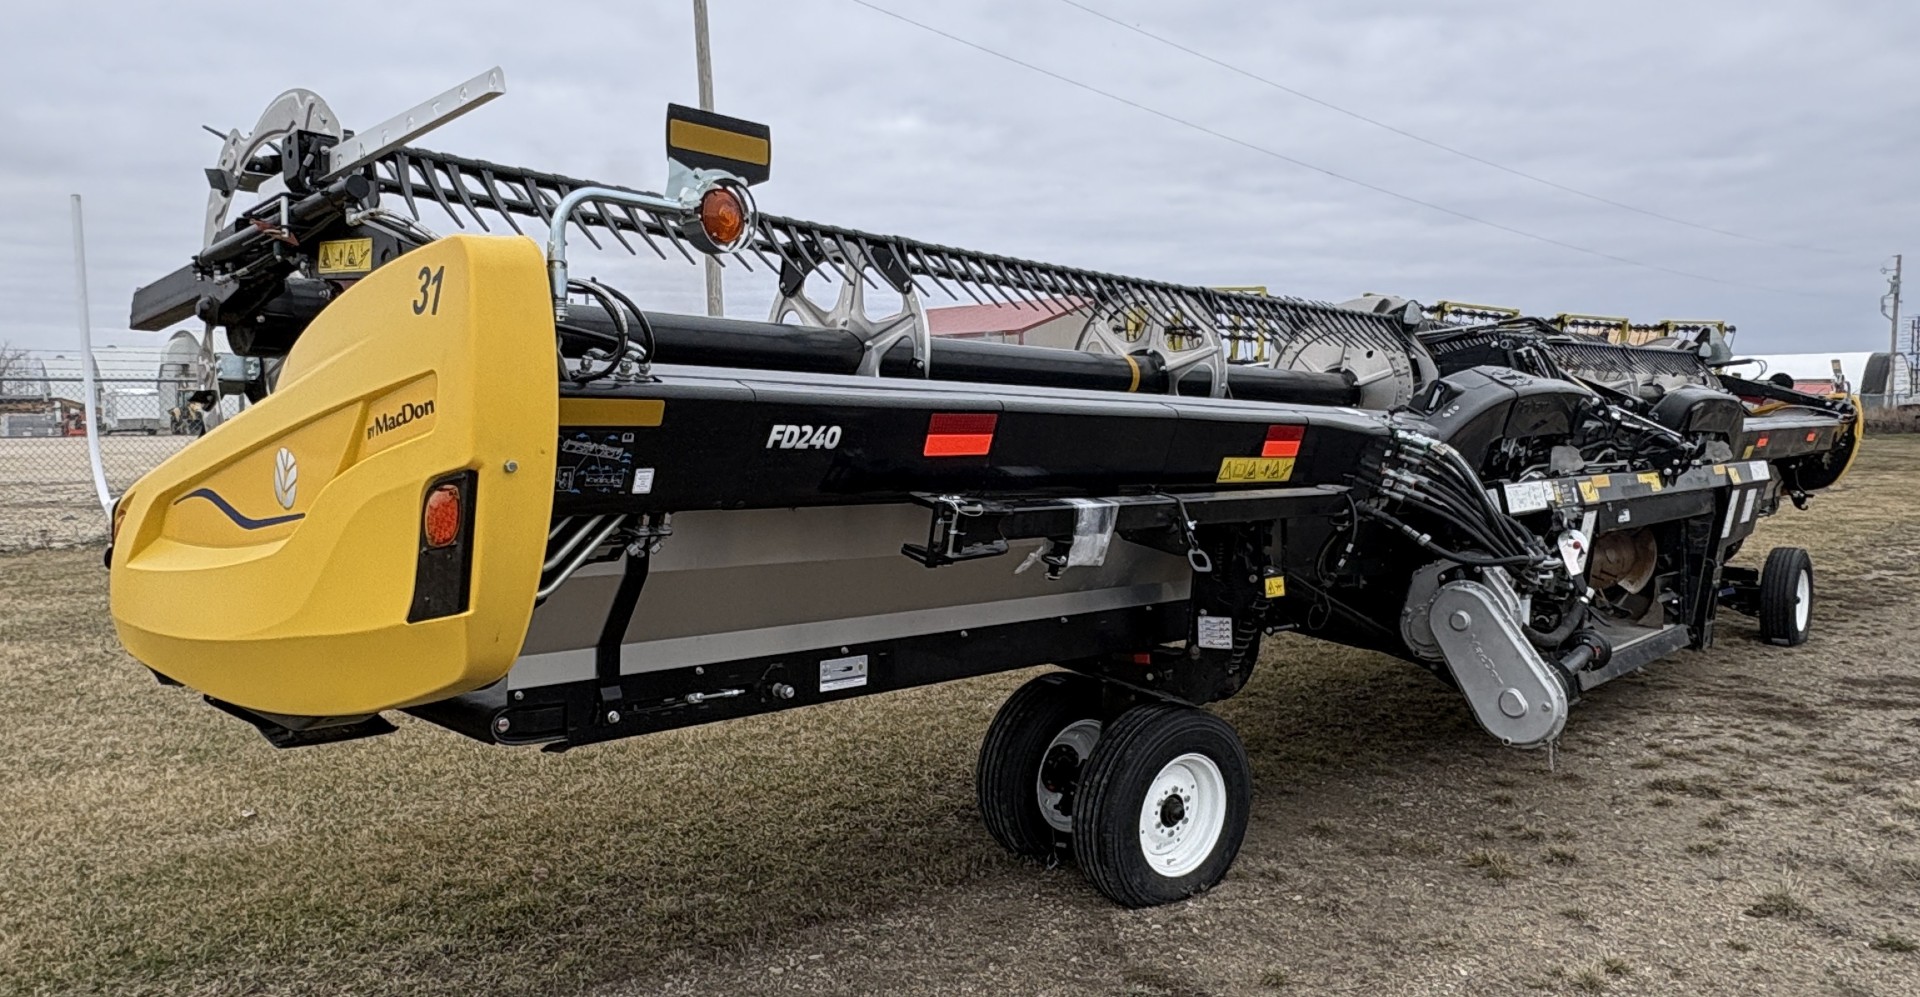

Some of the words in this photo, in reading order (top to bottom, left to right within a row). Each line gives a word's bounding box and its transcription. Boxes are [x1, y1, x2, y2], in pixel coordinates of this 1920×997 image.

[413, 265, 445, 316] 31
[375, 400, 435, 436] MacDon
[765, 424, 842, 450] FD240
